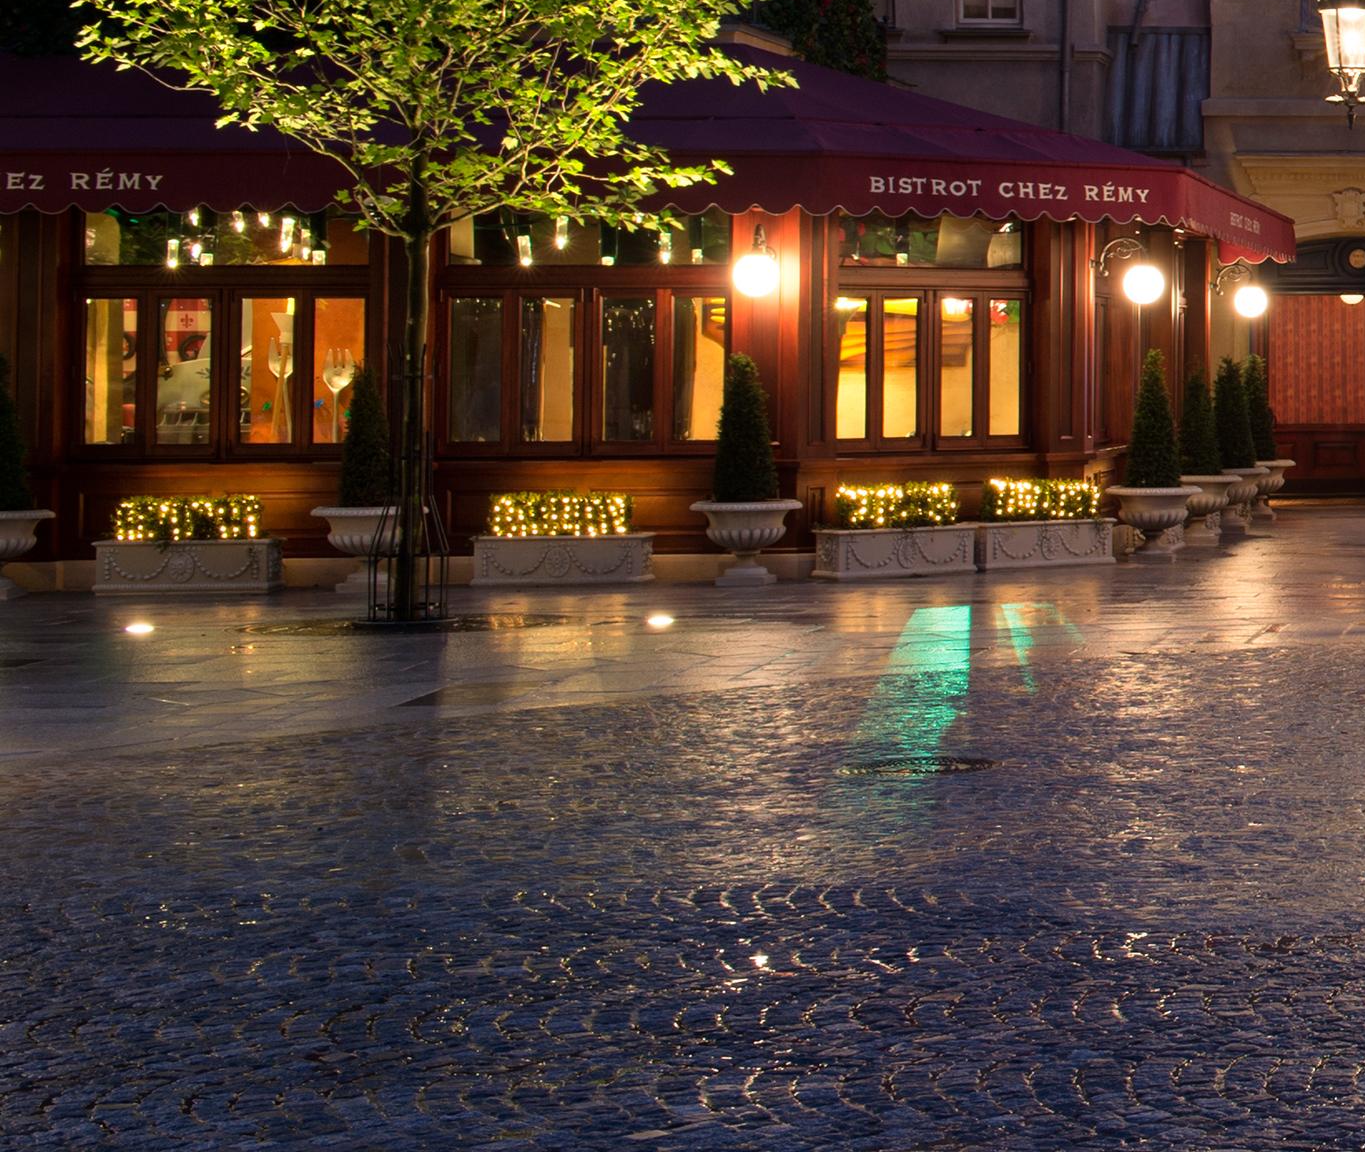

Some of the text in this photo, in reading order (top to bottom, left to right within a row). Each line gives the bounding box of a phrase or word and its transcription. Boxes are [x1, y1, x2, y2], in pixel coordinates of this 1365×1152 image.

[70, 168, 164, 190] RÉMY
[869, 176, 1151, 205] BISTROT CHEZ RÉMY
